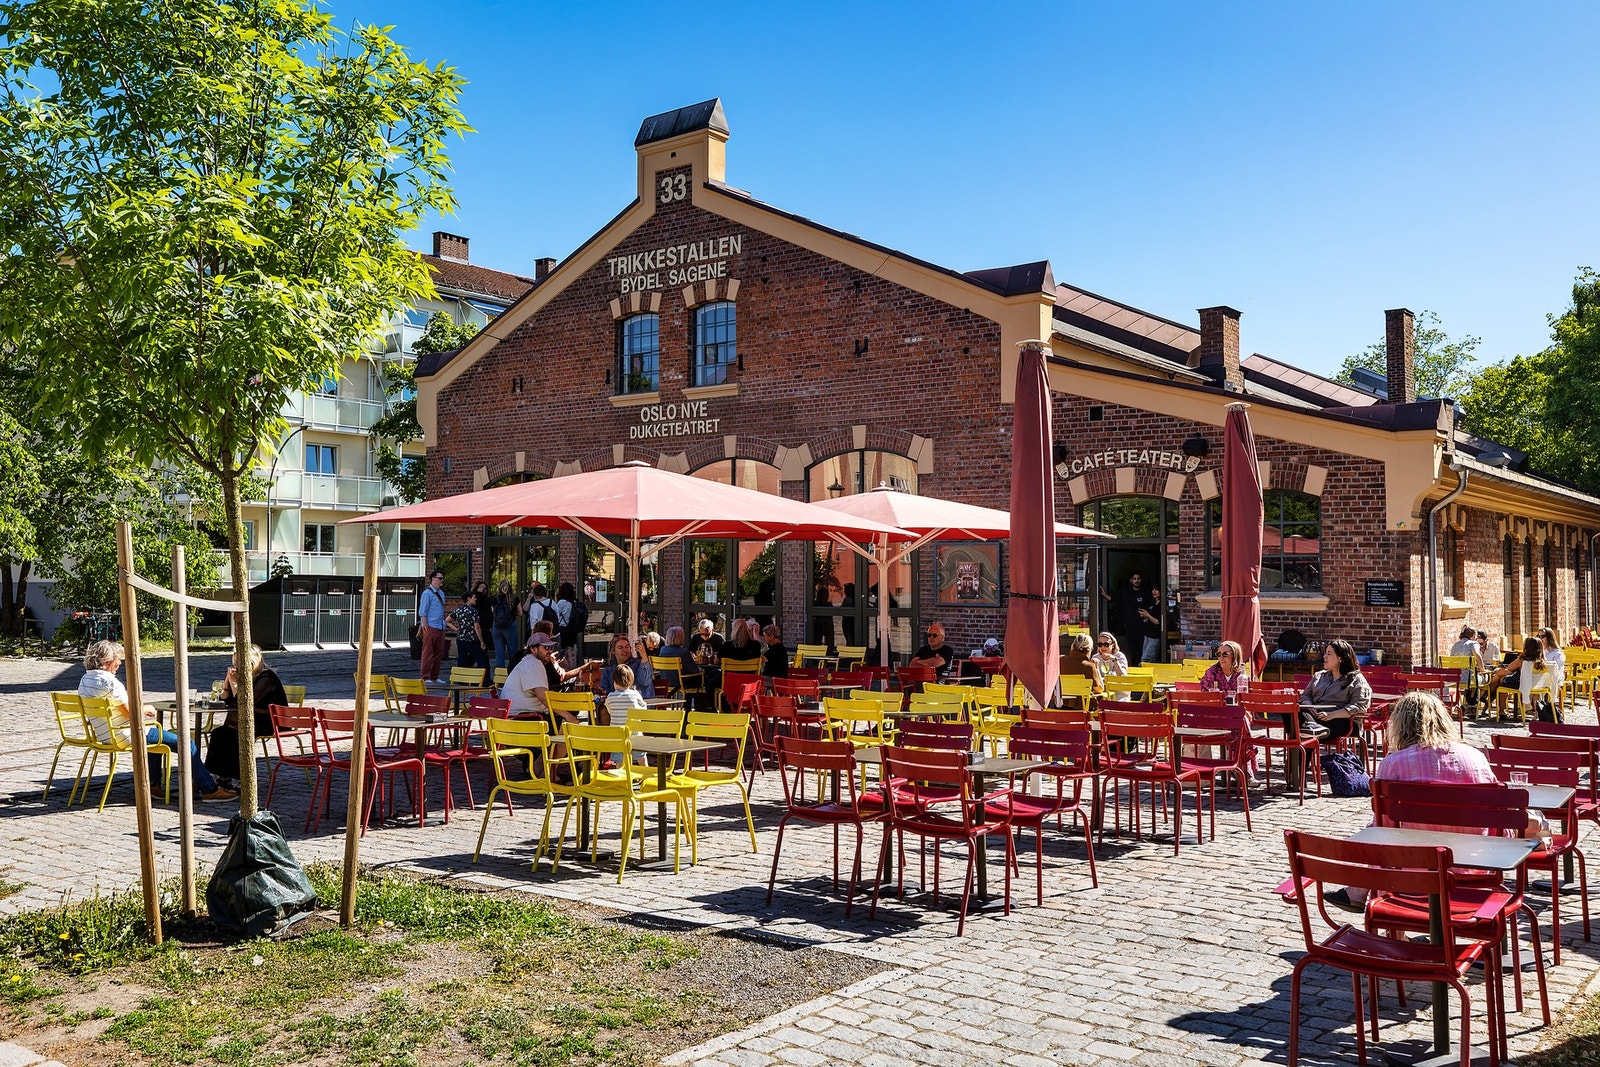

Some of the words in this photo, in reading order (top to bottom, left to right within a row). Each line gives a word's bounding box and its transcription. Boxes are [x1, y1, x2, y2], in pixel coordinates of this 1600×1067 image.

[660, 173, 687, 203] 33
[608, 234, 742, 277] TRIKKESTALLEN
[621, 273, 664, 294] BYDEL
[668, 260, 727, 286] SAGENE
[640, 403, 677, 422] OSLO
[681, 401, 708, 419] NYE
[629, 418, 720, 439] DUKKETEATRET
